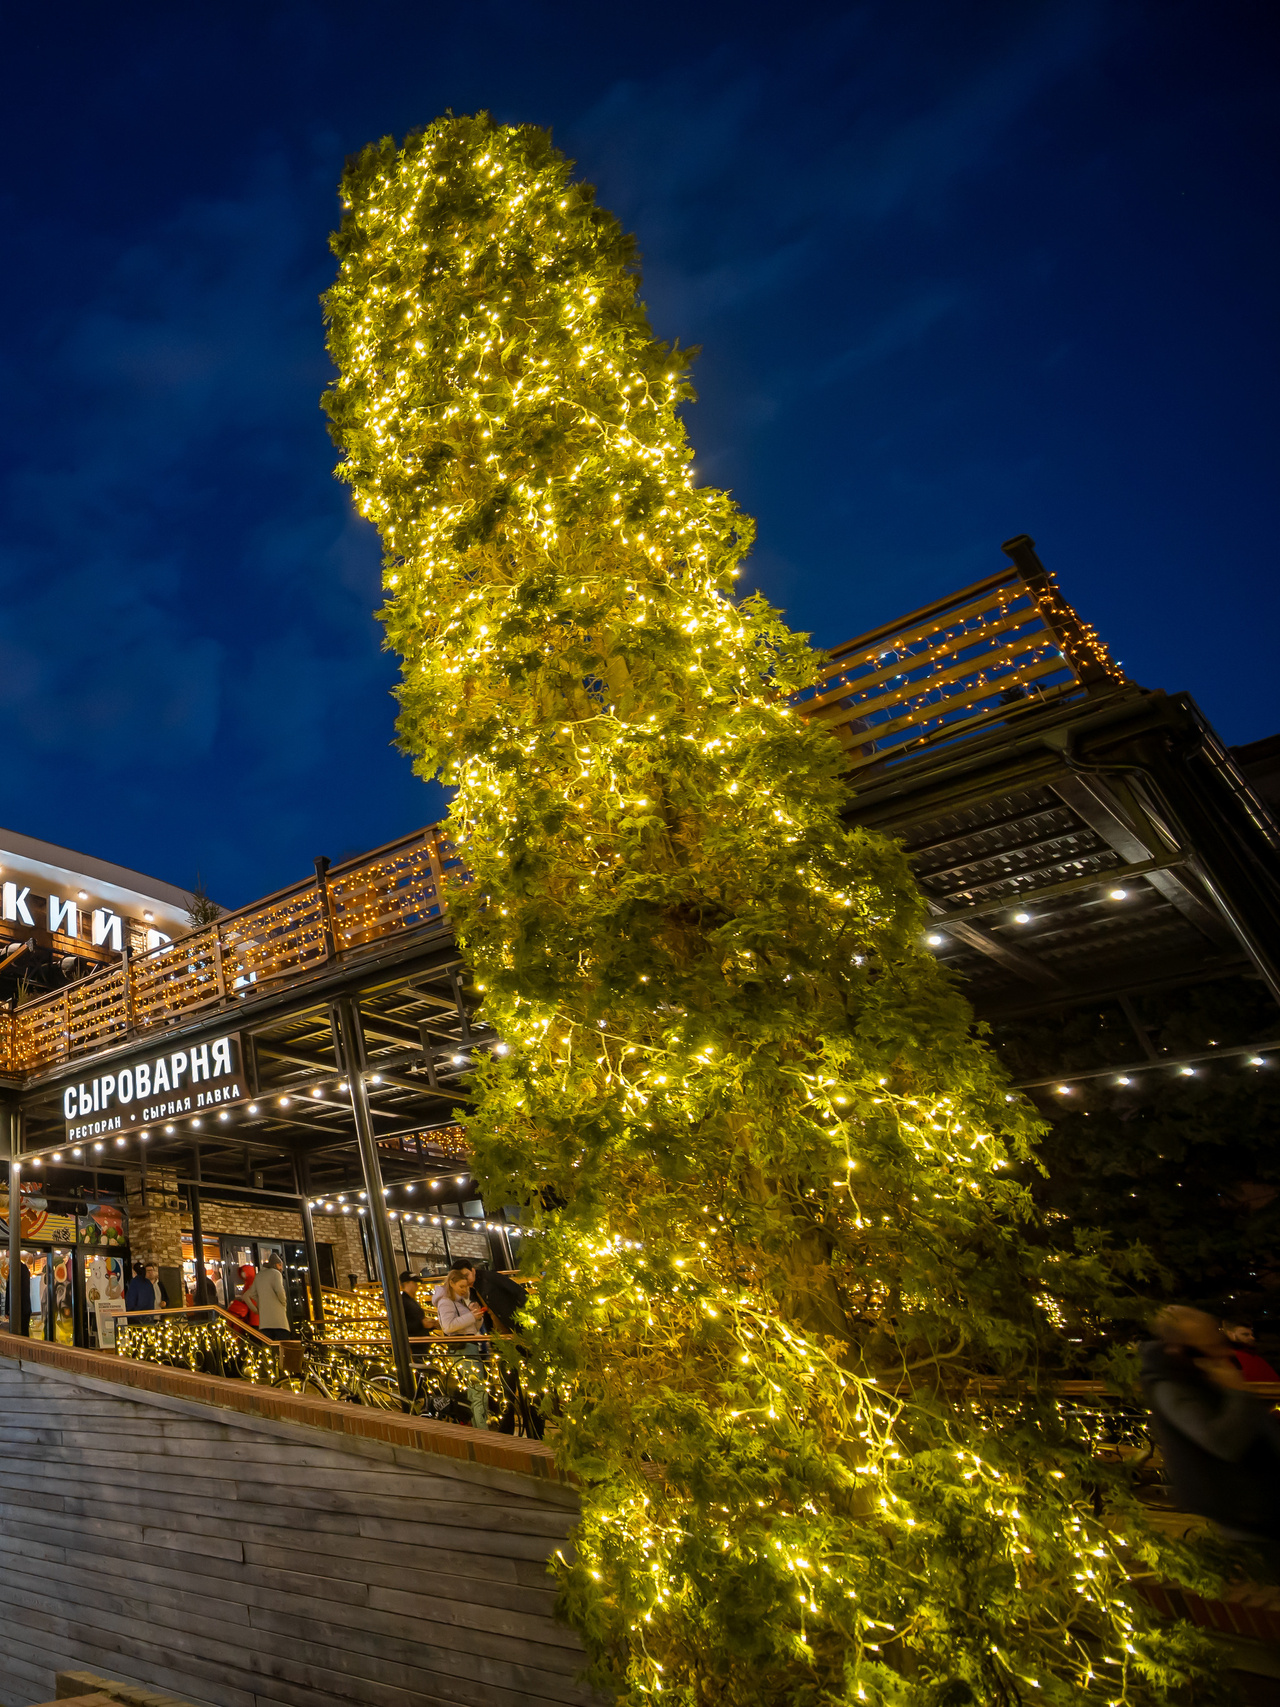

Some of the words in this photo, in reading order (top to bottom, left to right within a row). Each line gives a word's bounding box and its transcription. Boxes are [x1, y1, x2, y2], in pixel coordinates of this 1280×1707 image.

[64, 1036, 232, 1120] СЫРОВАРНЯ
[69, 1116, 121, 1141] РЕСТОРАН
[142, 1096, 191, 1121] СЫРНАЯ
[197, 1084, 240, 1107] ЛАВКА
